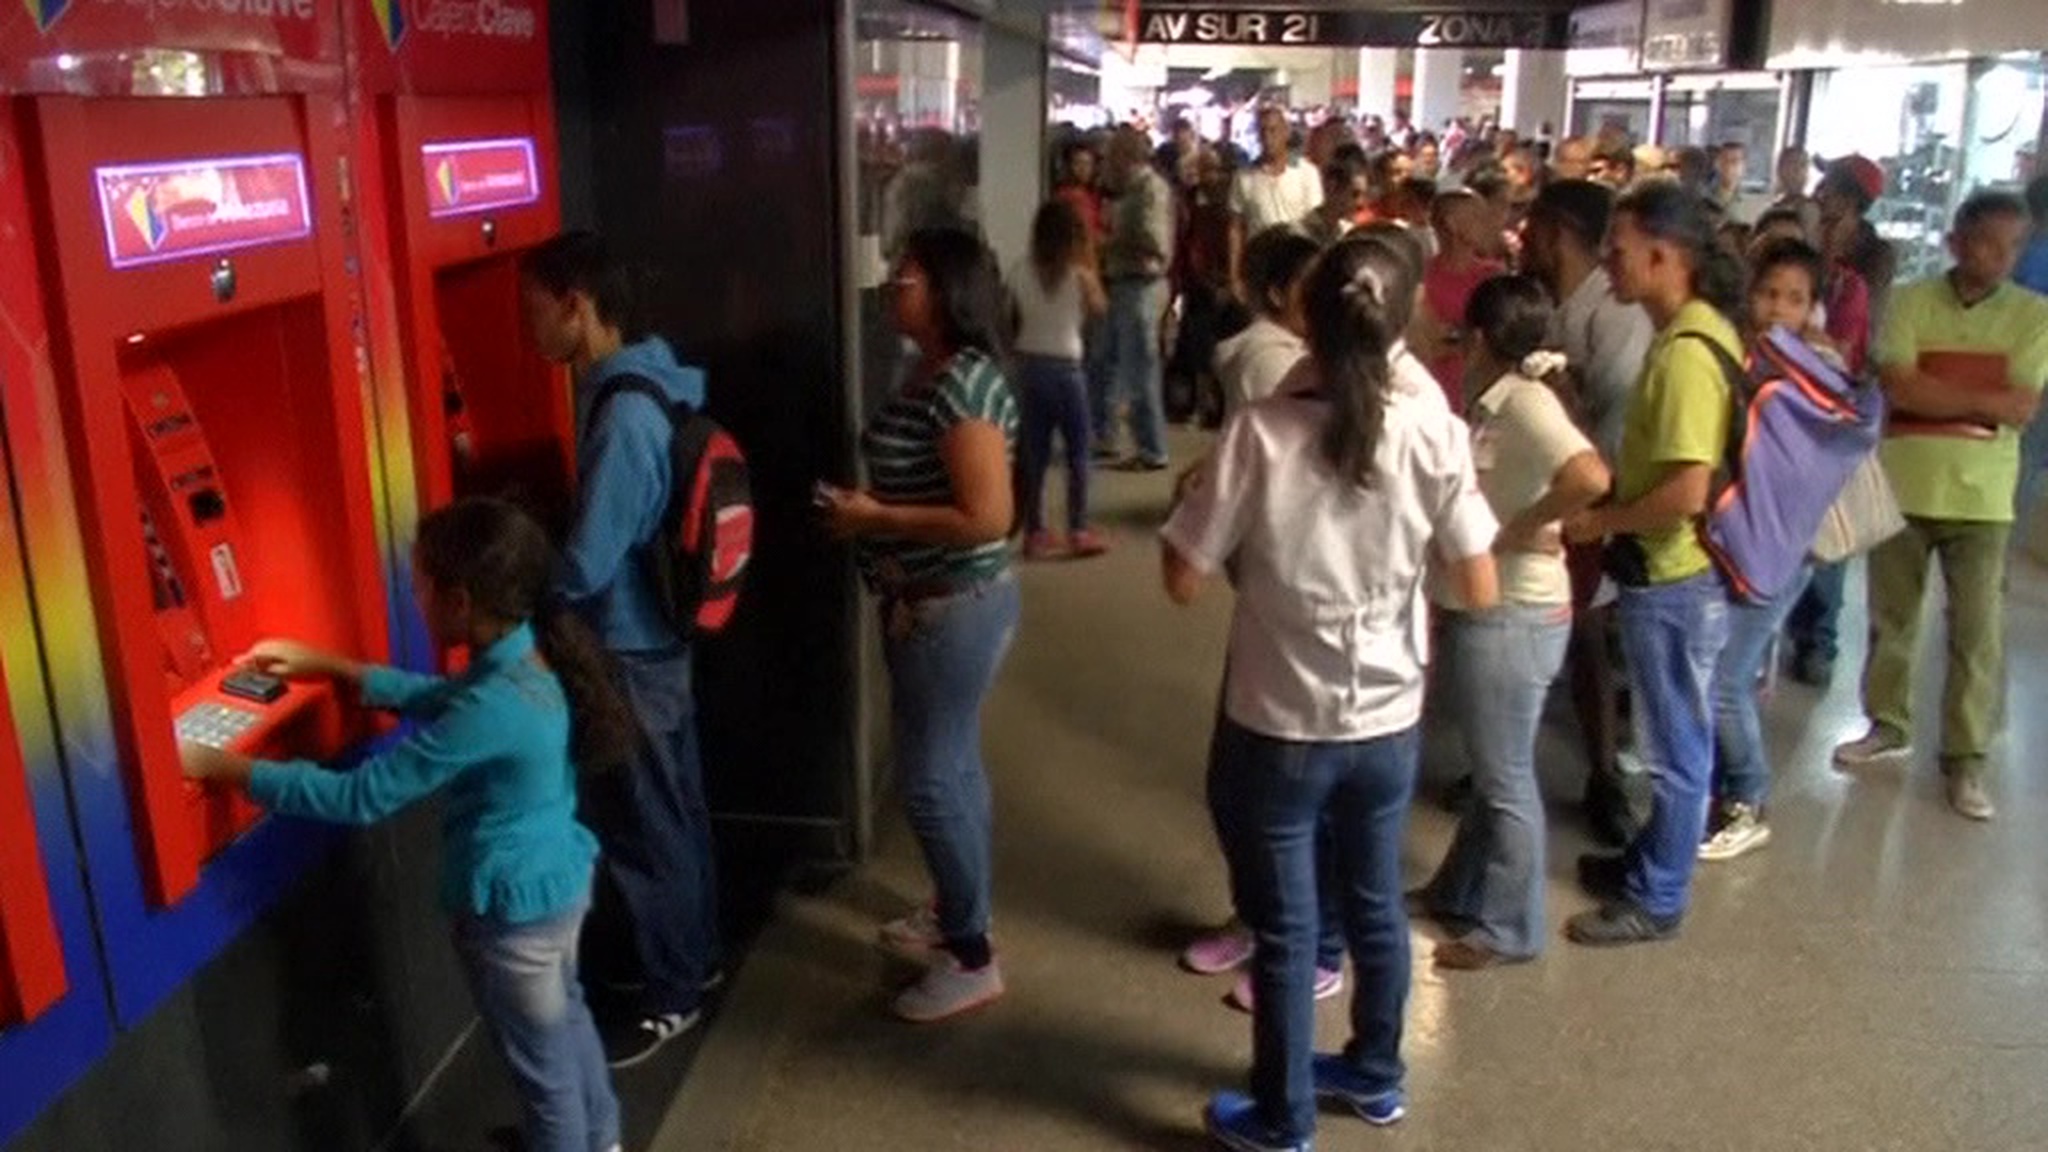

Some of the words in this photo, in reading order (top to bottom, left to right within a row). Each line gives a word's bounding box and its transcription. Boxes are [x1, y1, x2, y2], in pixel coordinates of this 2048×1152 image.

[1145, 13, 1188, 40] AV
[1196, 13, 1267, 42] SUR
[1281, 13, 1320, 42] 21
[1416, 14, 1514, 46] ZONA
